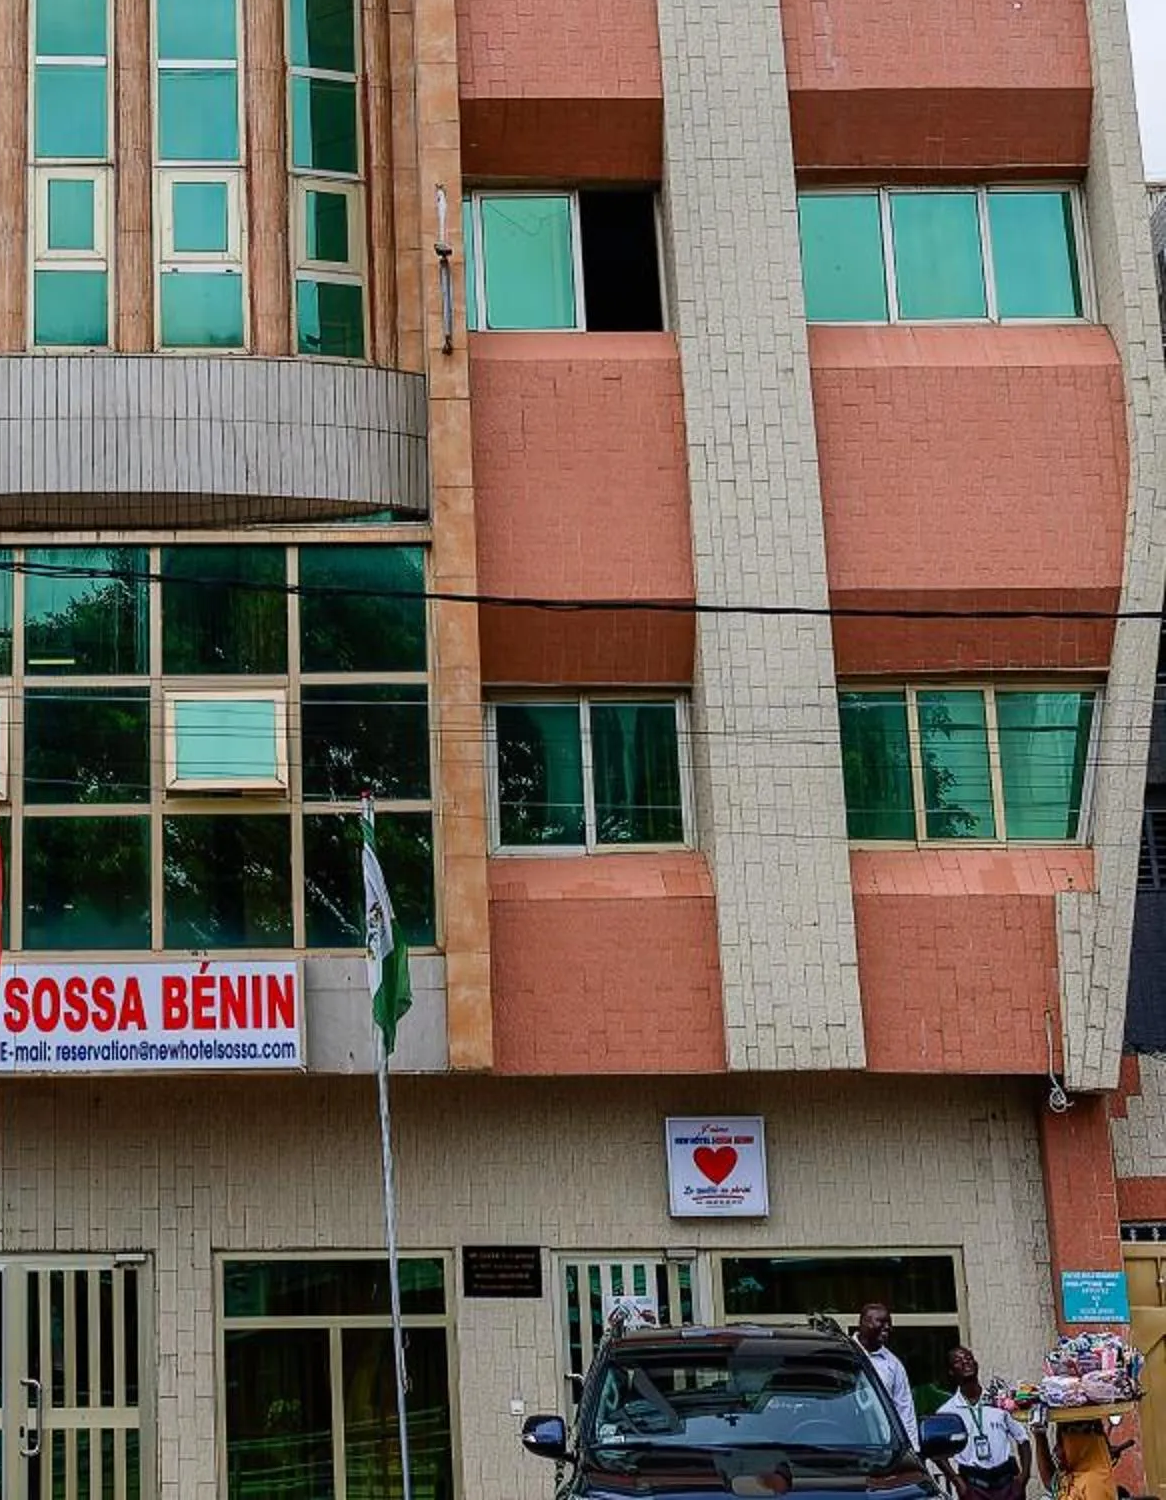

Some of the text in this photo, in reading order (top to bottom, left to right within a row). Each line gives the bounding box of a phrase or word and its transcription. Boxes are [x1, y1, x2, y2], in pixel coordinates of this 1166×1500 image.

[3, 975, 148, 1033] SOSSA
[161, 961, 295, 1031] BÉNIN
[0, 1040, 51, 1062] E-mail:
[55, 1039, 297, 1062] reservation@newhotelsossa.com
